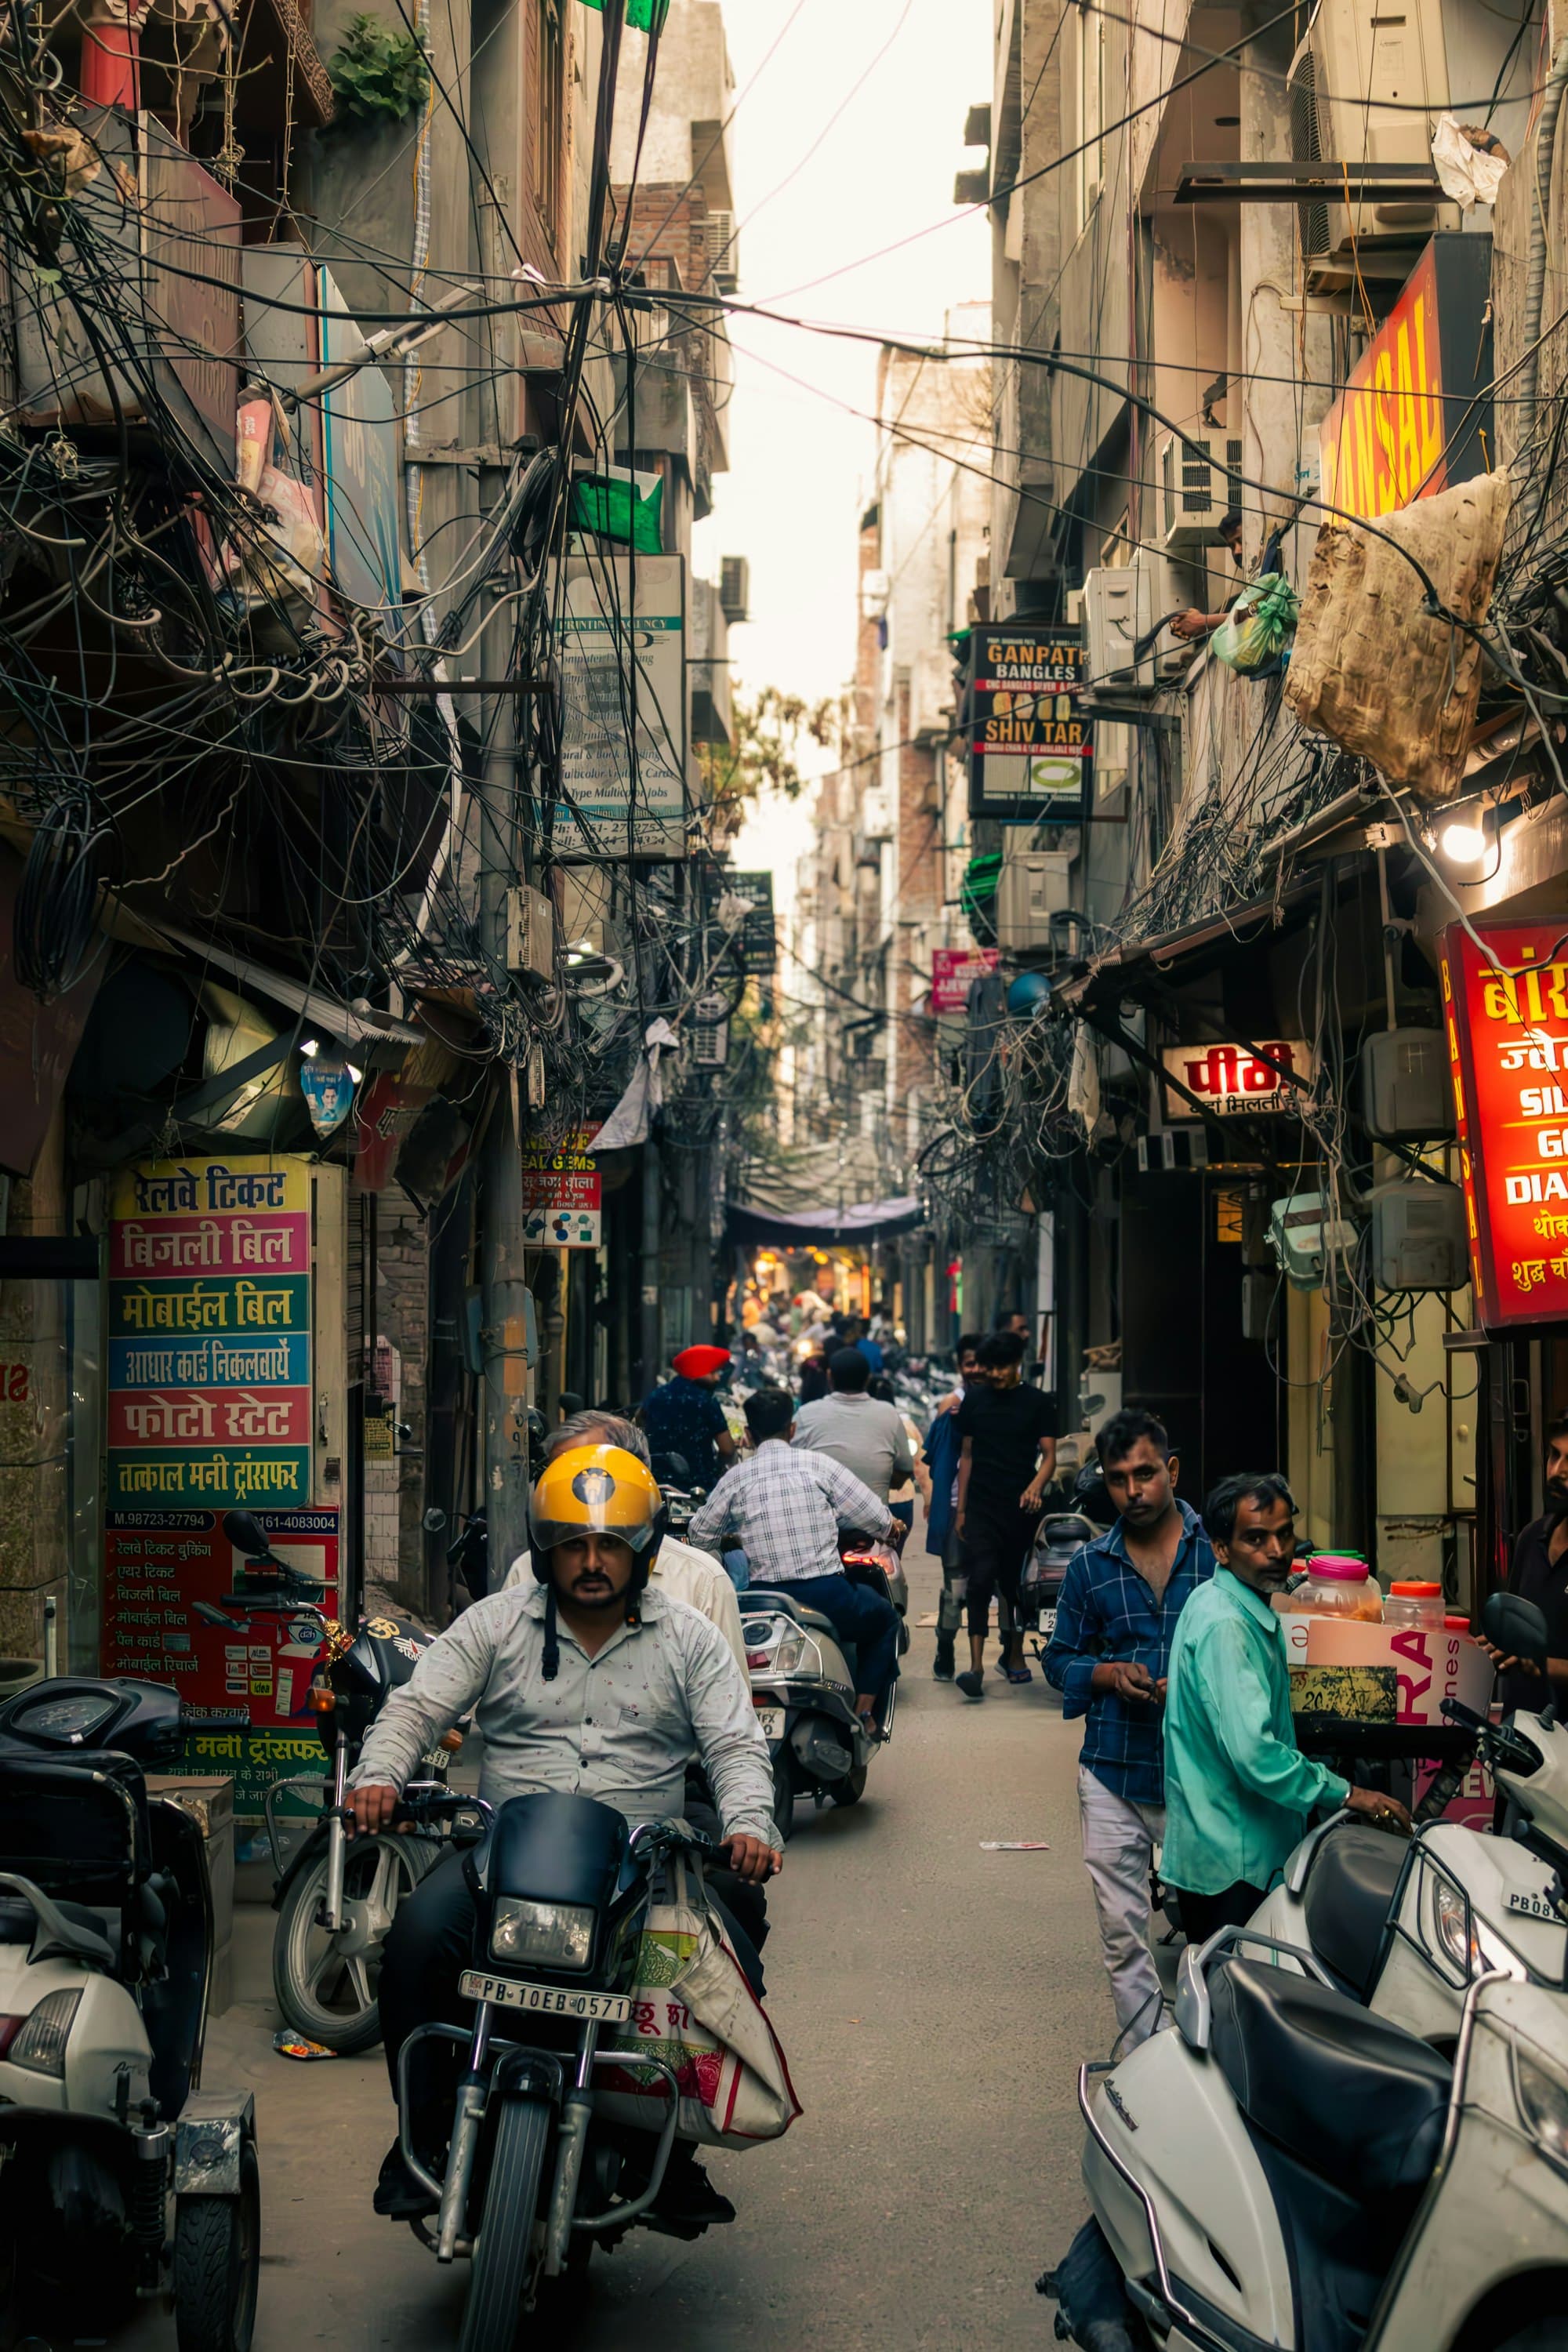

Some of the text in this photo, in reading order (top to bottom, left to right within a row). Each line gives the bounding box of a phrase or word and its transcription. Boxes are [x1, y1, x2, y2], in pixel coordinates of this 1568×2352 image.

[996, 663, 1076, 681] BANGLES
[985, 719, 1083, 744] SHIV TAR
[1227, 1092, 1279, 1112] मिलती
[552, 1154, 597, 1171] GEMS
[205, 1165, 287, 1210] टिकट
[122, 1219, 294, 1268] बिजली बिल
[122, 1280, 294, 1330] मोबाईल बिल
[125, 1350, 174, 1384] आधार
[176, 1340, 210, 1382] कार्ड
[123, 1392, 293, 1439] फोटो स्टेट
[189, 1454, 230, 1491] मनी
[234, 1452, 299, 1500] ट्रांसफर
[114, 1512, 205, 1527] M.98723-27794
[144, 1538, 176, 1556] टिकट
[144, 1563, 176, 1579] टिकट
[117, 1584, 181, 1602] बिजली बिल
[164, 1609, 187, 1626] बिल
[483, 1980, 506, 2001] PB
[577, 1996, 624, 2020] 0571
